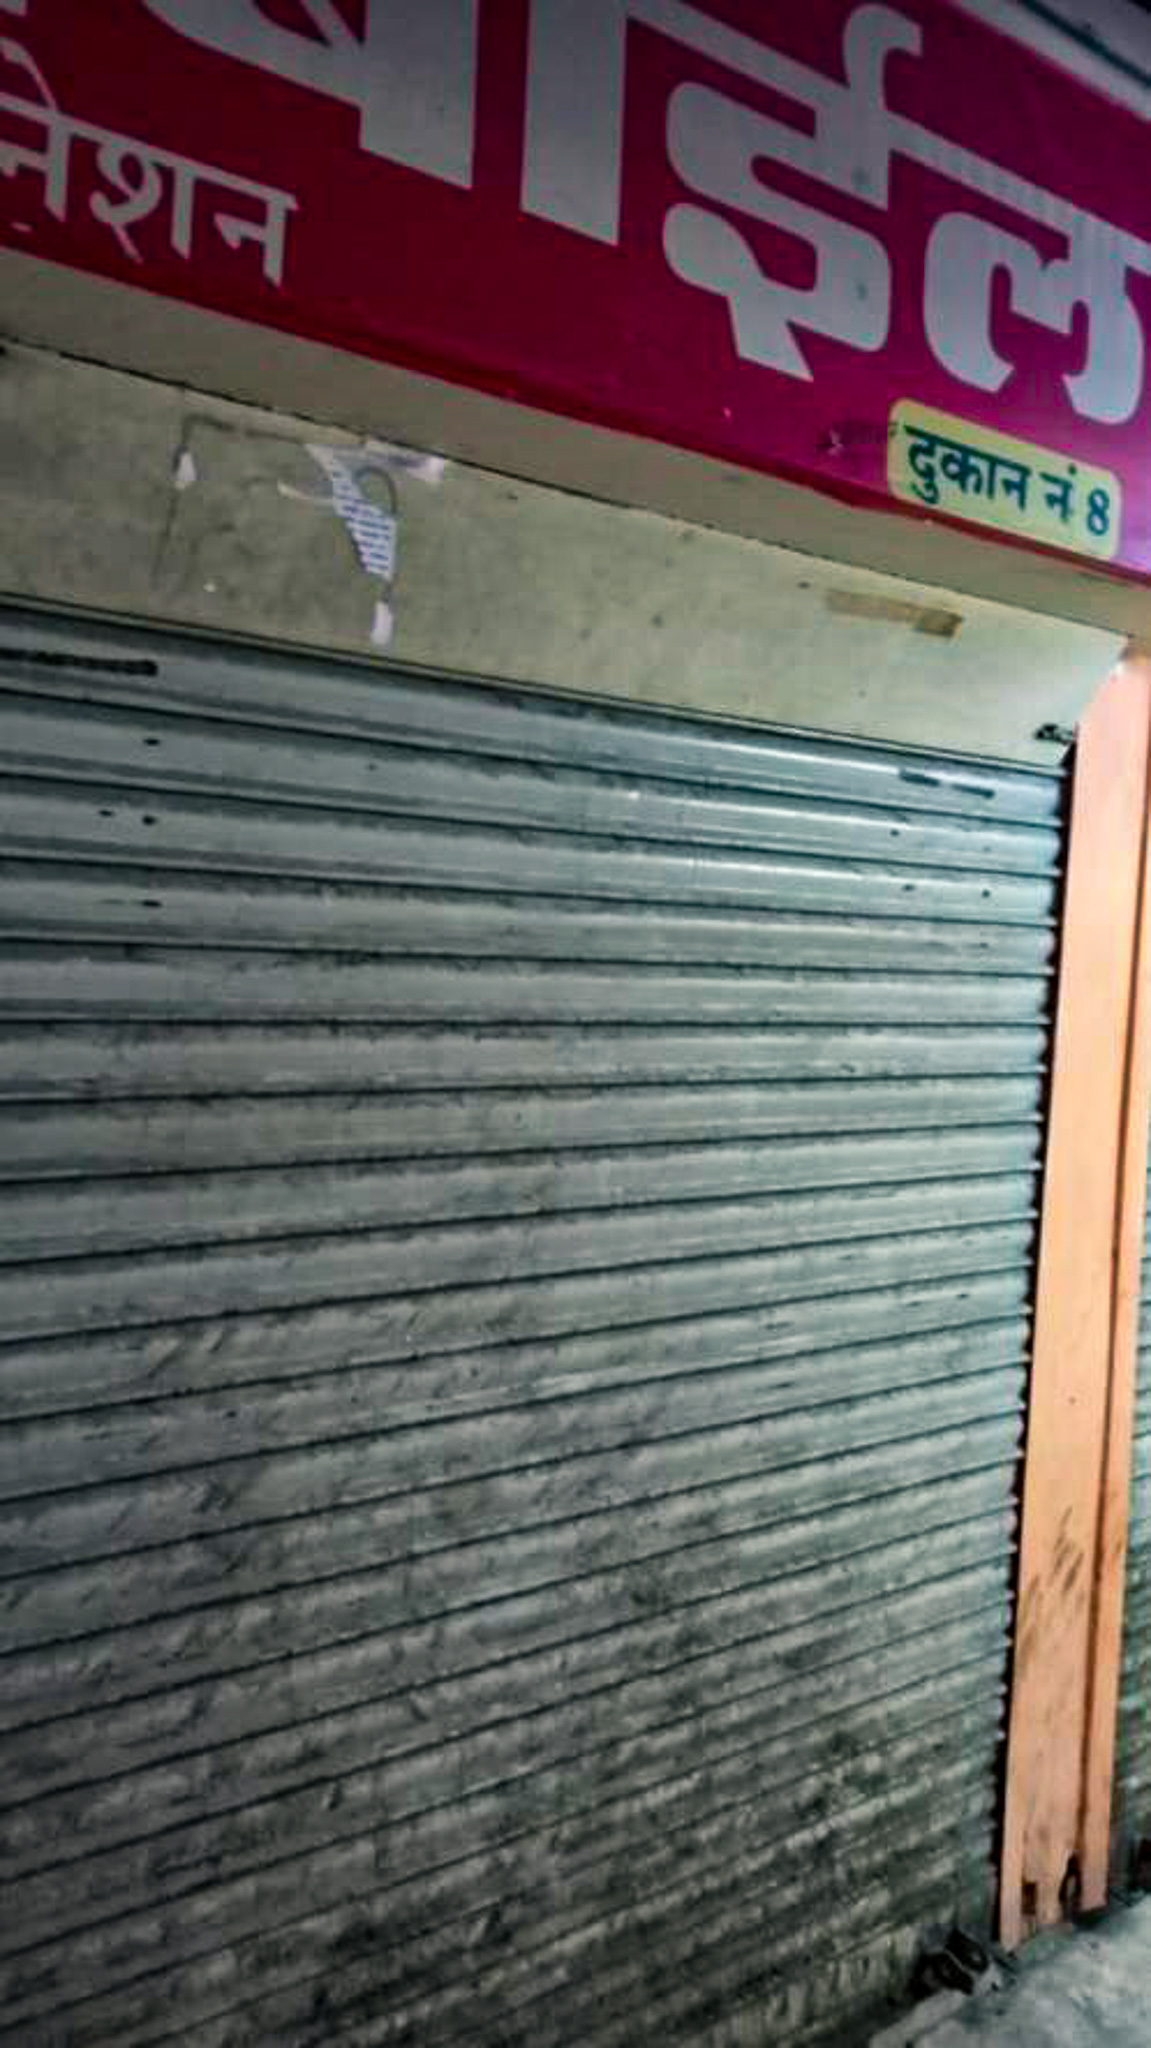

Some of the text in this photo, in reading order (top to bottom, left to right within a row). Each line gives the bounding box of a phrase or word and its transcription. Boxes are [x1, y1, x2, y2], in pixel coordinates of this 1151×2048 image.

[903, 424, 1110, 536] दुकान नं 8
